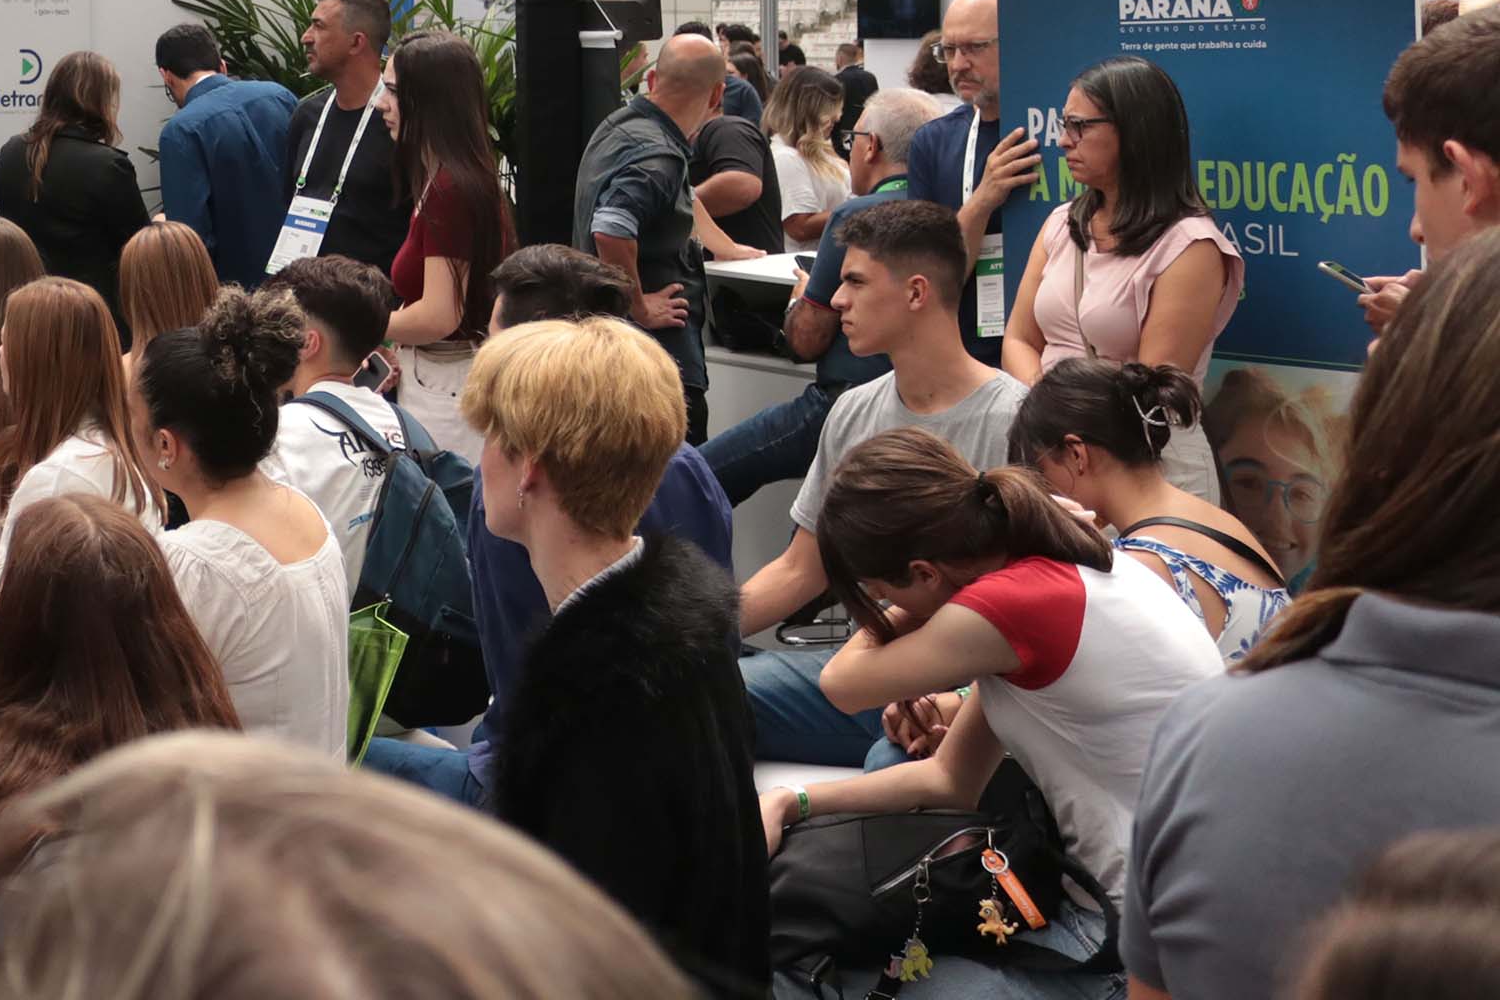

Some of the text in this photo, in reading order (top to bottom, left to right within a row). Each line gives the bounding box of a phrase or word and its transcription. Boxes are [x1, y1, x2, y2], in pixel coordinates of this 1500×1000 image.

[1121, 42, 1141, 50] Terra
[1143, 42, 1153, 50] de
[1155, 43, 1179, 51] gente
[1180, 43, 1197, 51] que
[1198, 41, 1233, 49] trabalha
[1243, 40, 1267, 48] cuida
[1198, 153, 1389, 223] EDUCAÇÃO
[1223, 222, 1299, 256] ASIL
